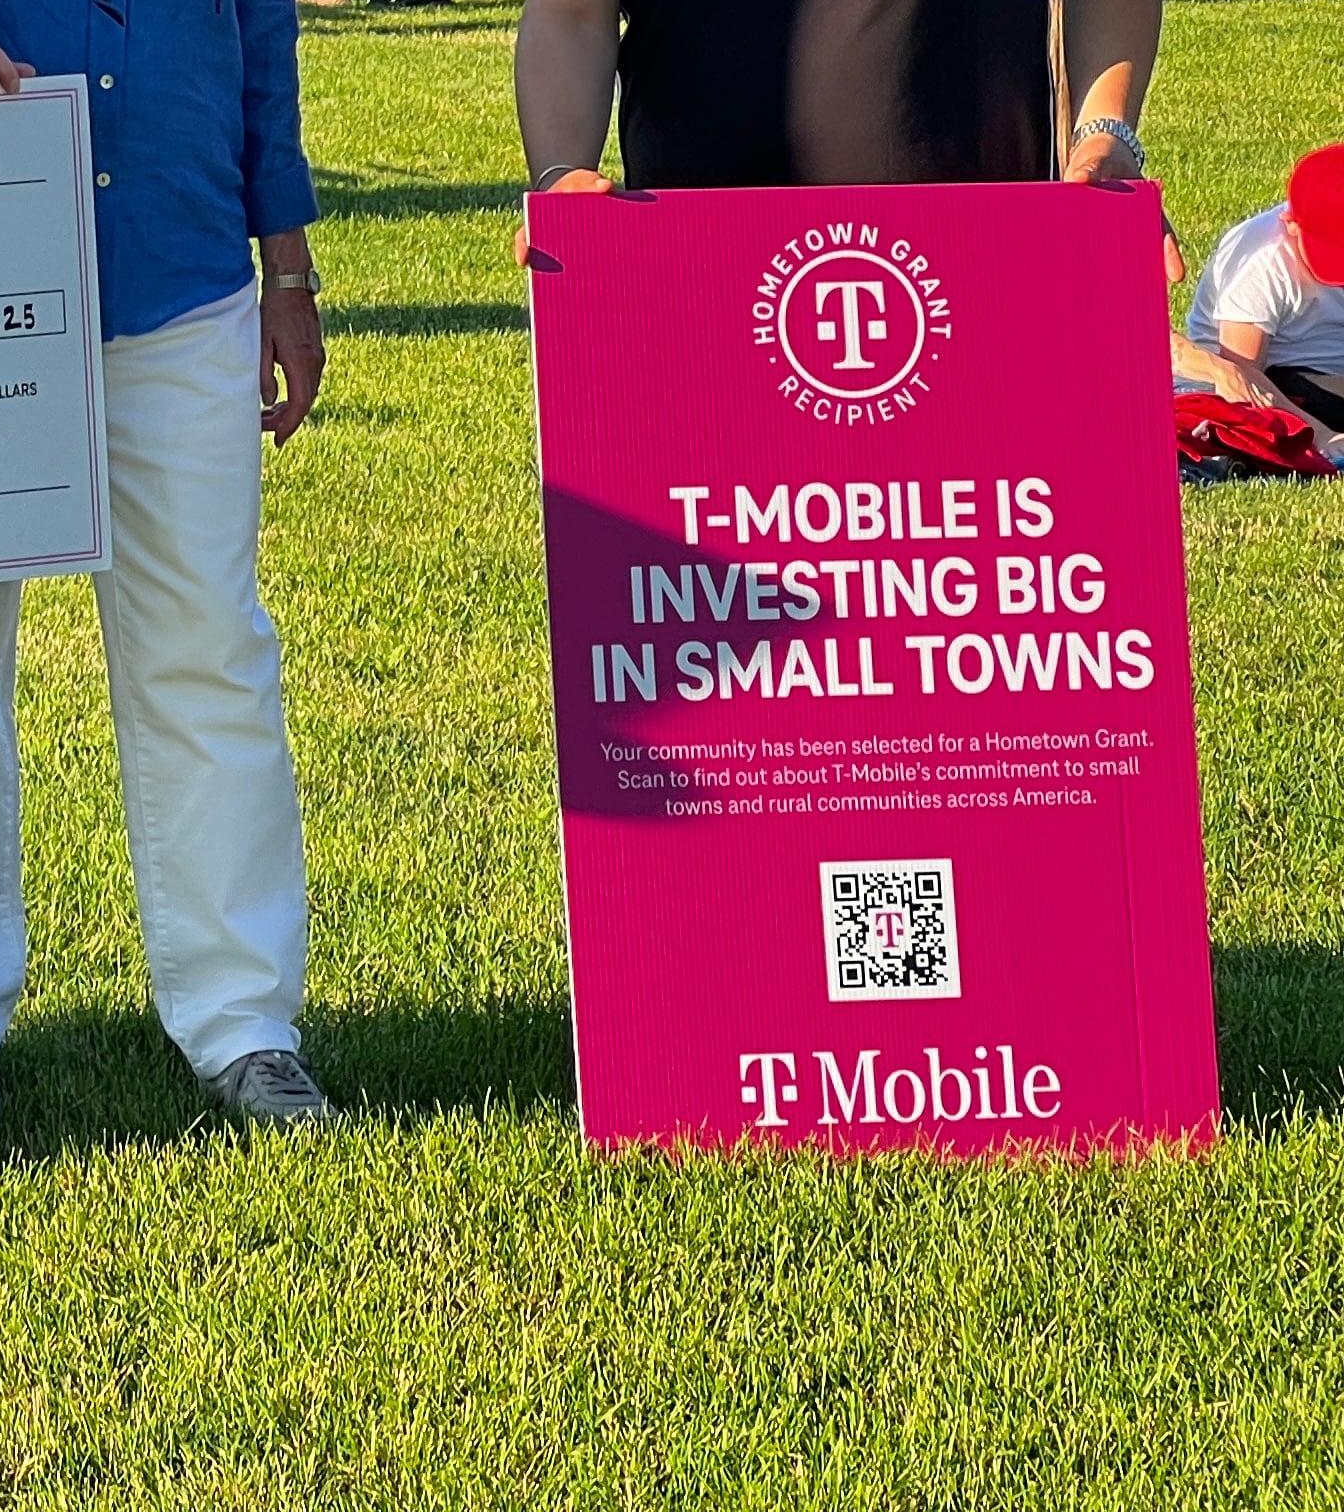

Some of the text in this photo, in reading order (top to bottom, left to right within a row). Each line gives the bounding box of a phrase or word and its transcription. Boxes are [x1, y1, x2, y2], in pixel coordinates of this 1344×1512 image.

[752, 221, 951, 345] HOMETOWN GRANT
[815, 281, 888, 370] T
[778, 372, 930, 426] RECIPIENT
[669, 477, 1055, 545] T-MOBILE IS
[629, 553, 1106, 625] INVESTING BIG
[591, 629, 1156, 703] IN SMALL TOWNS
[600, 728, 1154, 763] Your community has been selected for a Hometown Grant.
[617, 769, 664, 790] Scan
[669, 770, 689, 788] to
[693, 767, 731, 787] find
[735, 767, 768, 786] out
[772, 765, 828, 785] about
[935, 759, 1060, 781] commitment
[1063, 759, 1085, 778] to
[1089, 755, 1141, 777] small
[665, 786, 1097, 817] towns and rural communities across America.
[739, 1045, 1062, 1127] T Mobile
